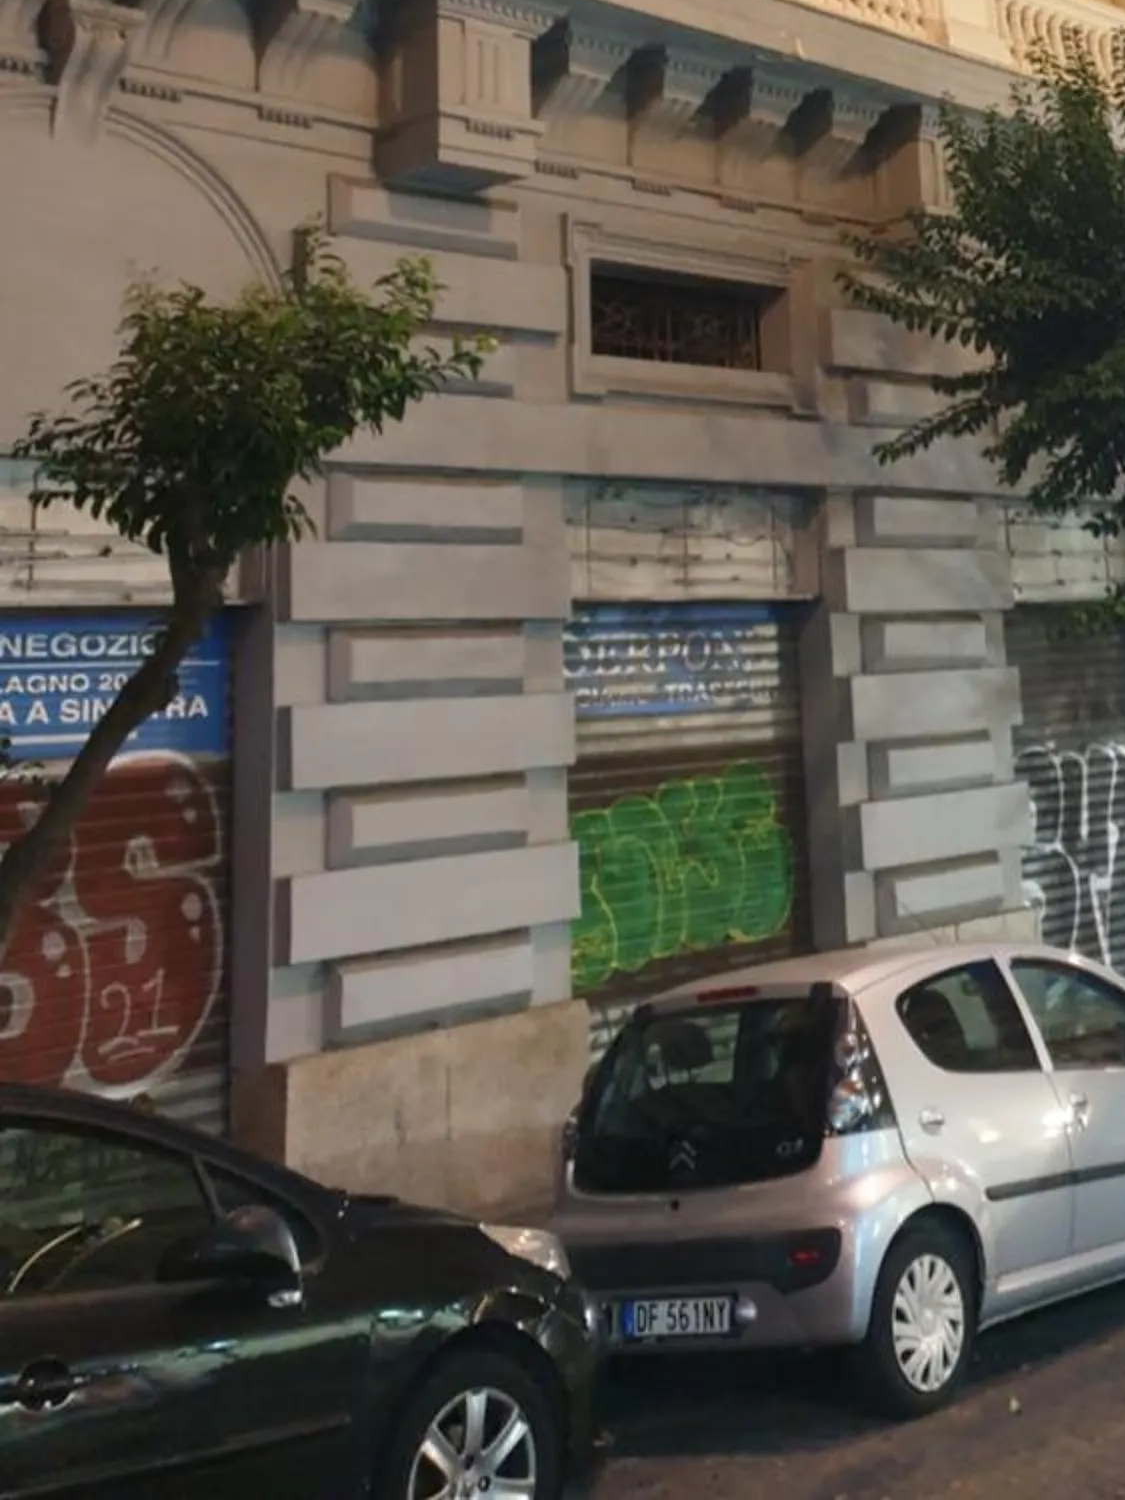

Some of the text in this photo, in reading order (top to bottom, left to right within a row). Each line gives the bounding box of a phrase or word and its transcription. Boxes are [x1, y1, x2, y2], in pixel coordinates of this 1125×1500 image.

[0, 673, 90, 694] AGNO
[26, 700, 50, 725] A
[59, 694, 208, 724] SINRA
[636, 1300, 727, 1334] DF 561NY
